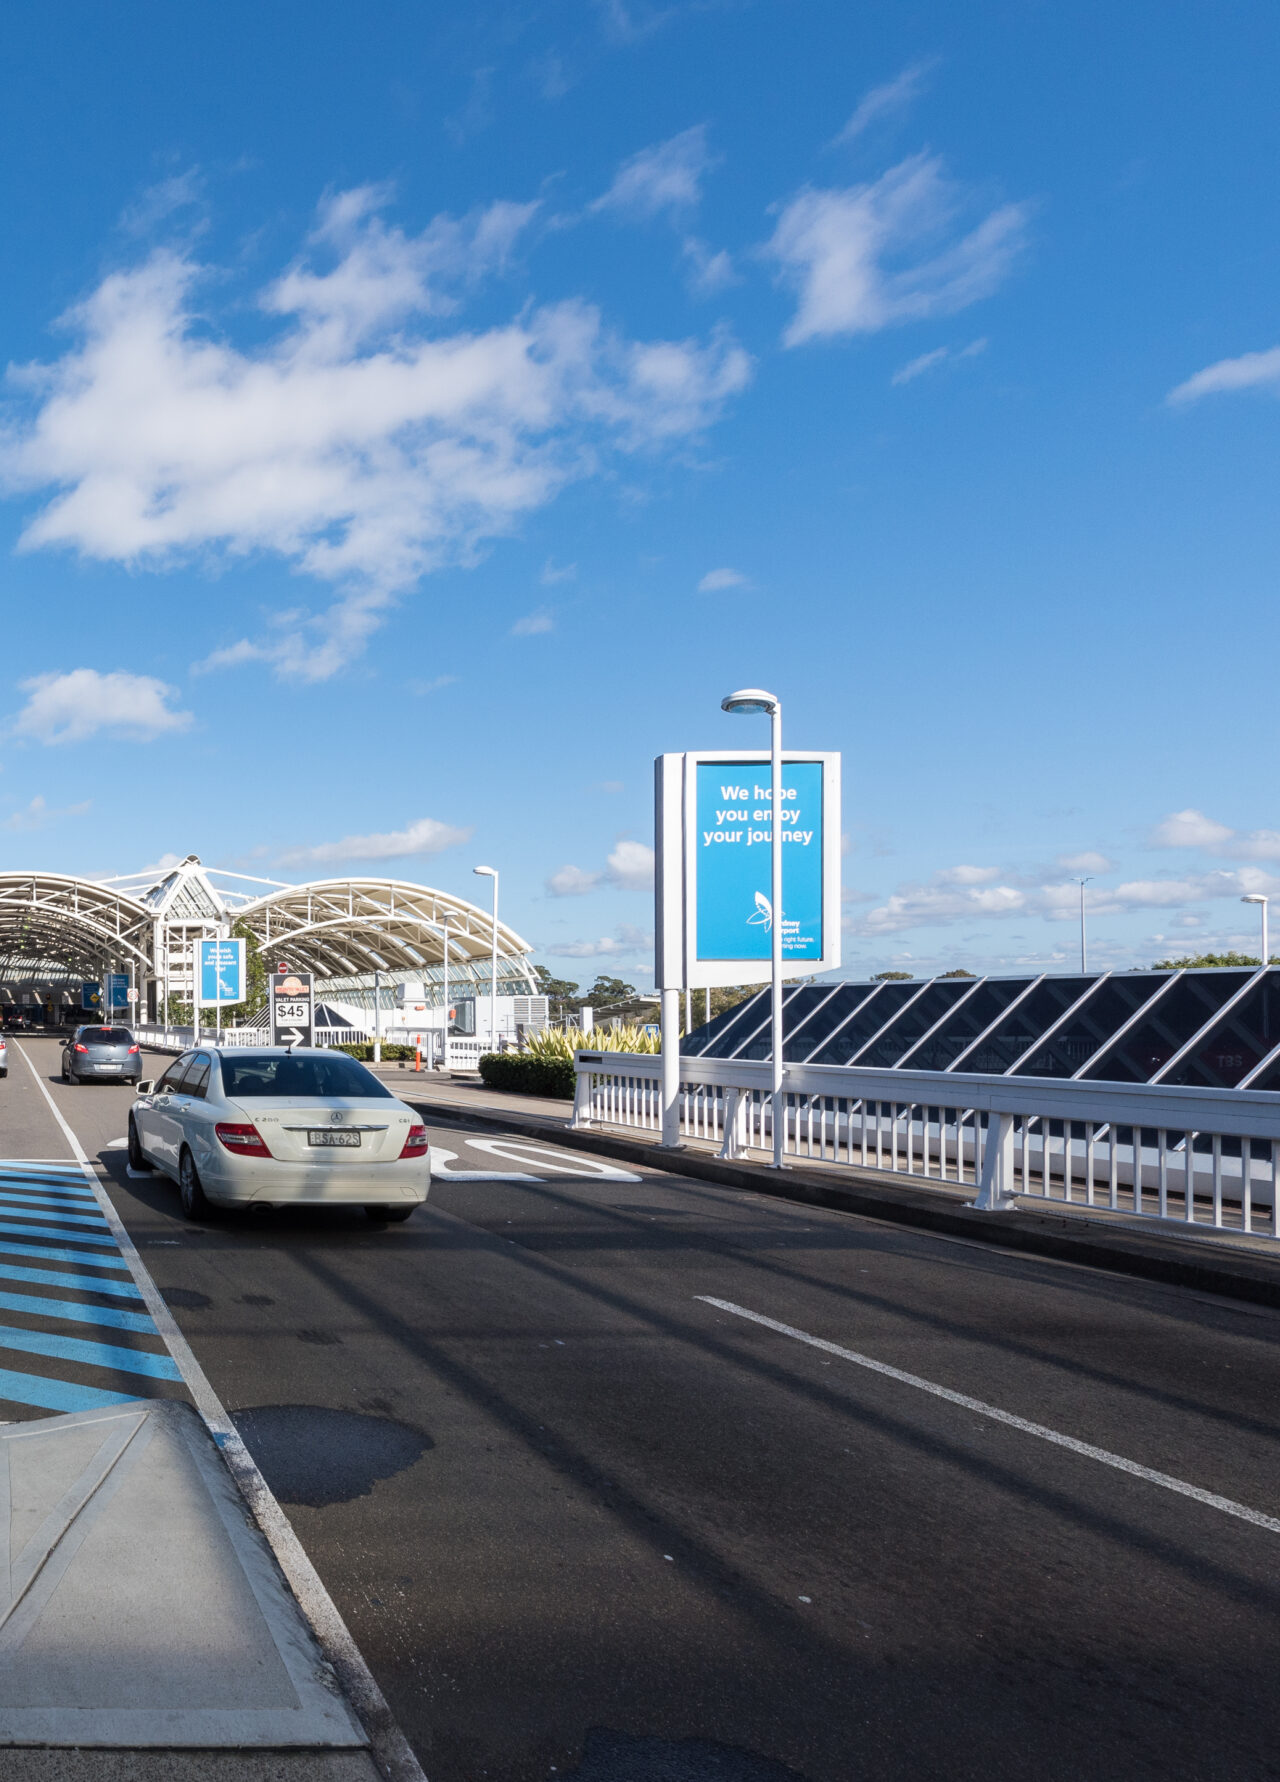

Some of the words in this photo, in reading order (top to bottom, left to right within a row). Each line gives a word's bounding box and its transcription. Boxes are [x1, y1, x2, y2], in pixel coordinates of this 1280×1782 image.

[721, 786, 749, 800] We
[715, 810, 748, 825] you
[753, 809, 801, 825] enoy
[703, 831, 744, 846] your
[746, 827, 813, 846] jouney
[278, 1005, 304, 1018] $45
